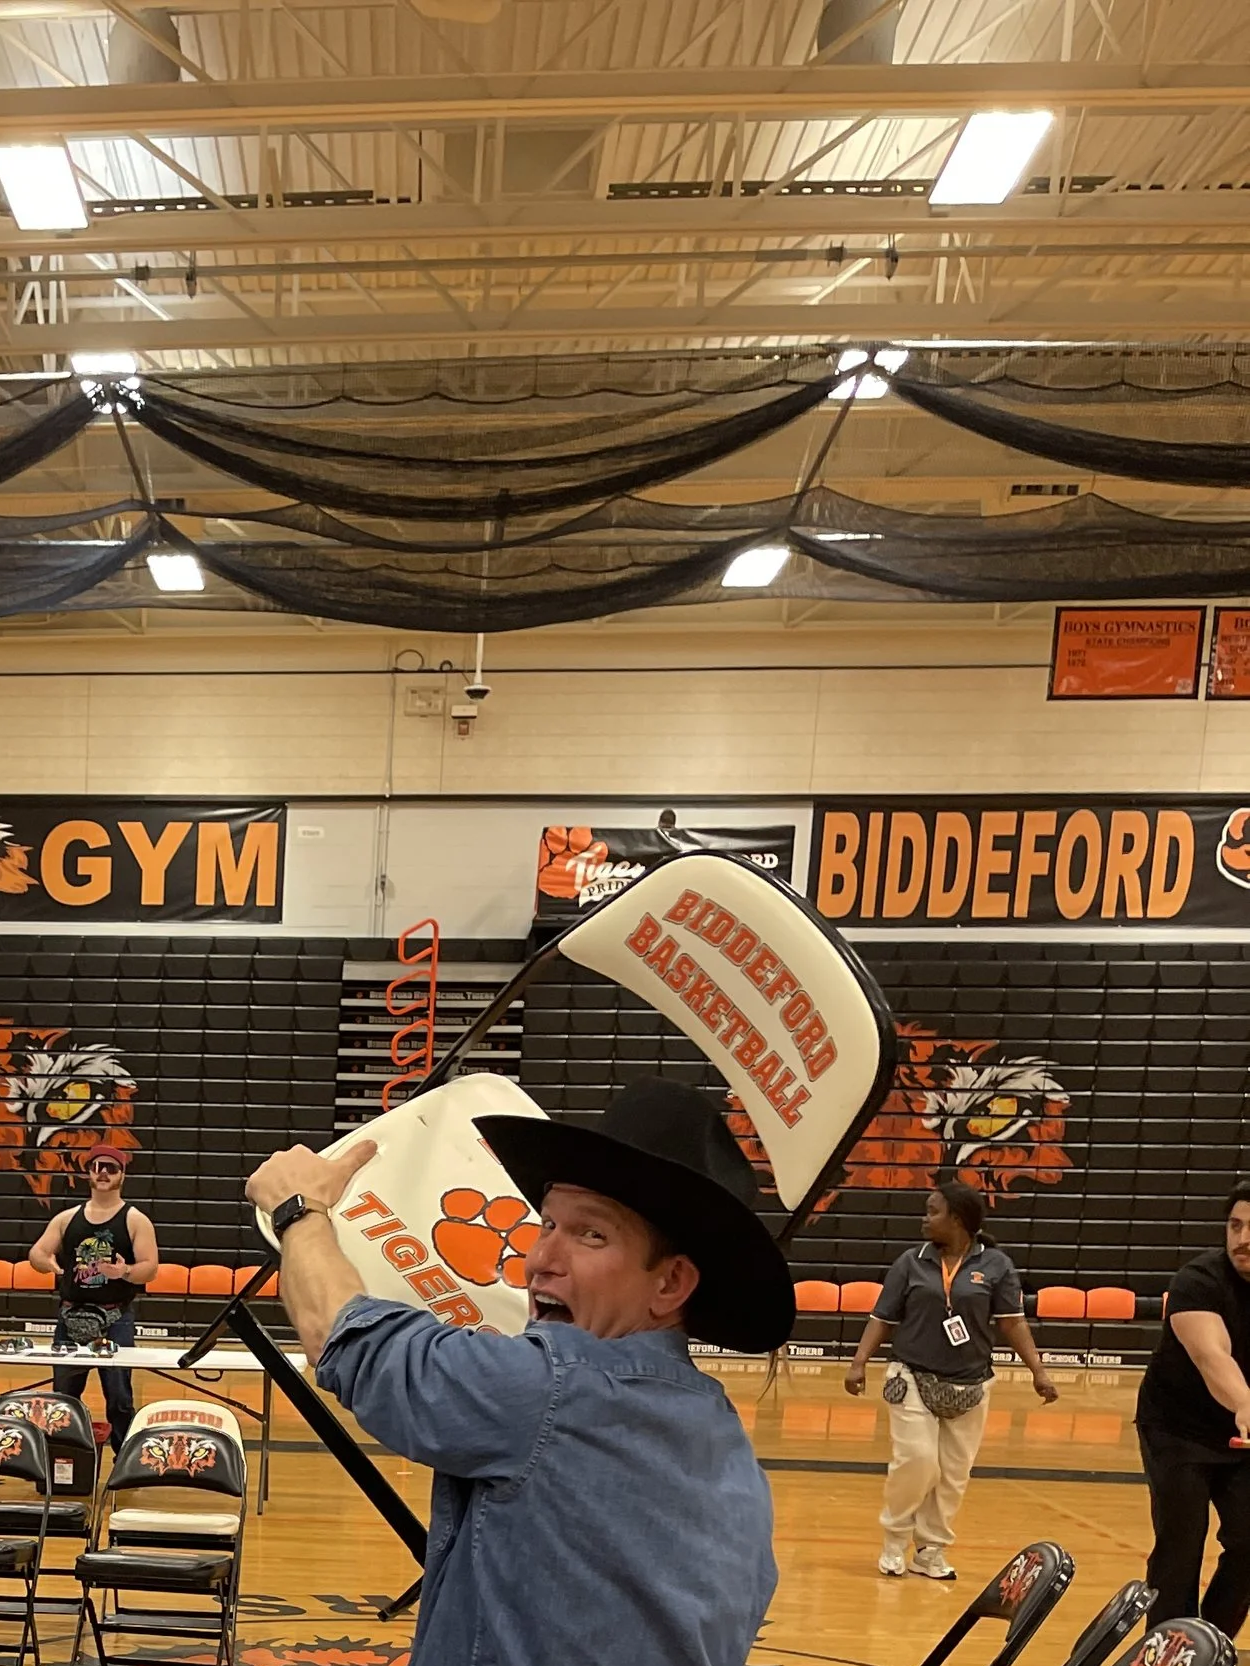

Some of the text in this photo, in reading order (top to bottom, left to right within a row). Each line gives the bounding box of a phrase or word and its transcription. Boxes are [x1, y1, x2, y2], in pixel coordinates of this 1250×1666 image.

[1063, 620, 1196, 634] BOYS GYMNASTICS
[39, 818, 280, 908] GYM
[816, 809, 1196, 921] BIDDEFORD
[586, 879, 632, 897] PRID
[663, 886, 840, 1085] BIDDEFORD
[623, 911, 814, 1131] BASKETBALL
[339, 1190, 502, 1336] TIGER
[135, 1325, 169, 1337] TIGERS
[788, 1344, 825, 1356] TIGERS
[1041, 1352, 1122, 1365] SCHOOL TIGERS
[146, 1409, 224, 1430] BIDDEFORD
